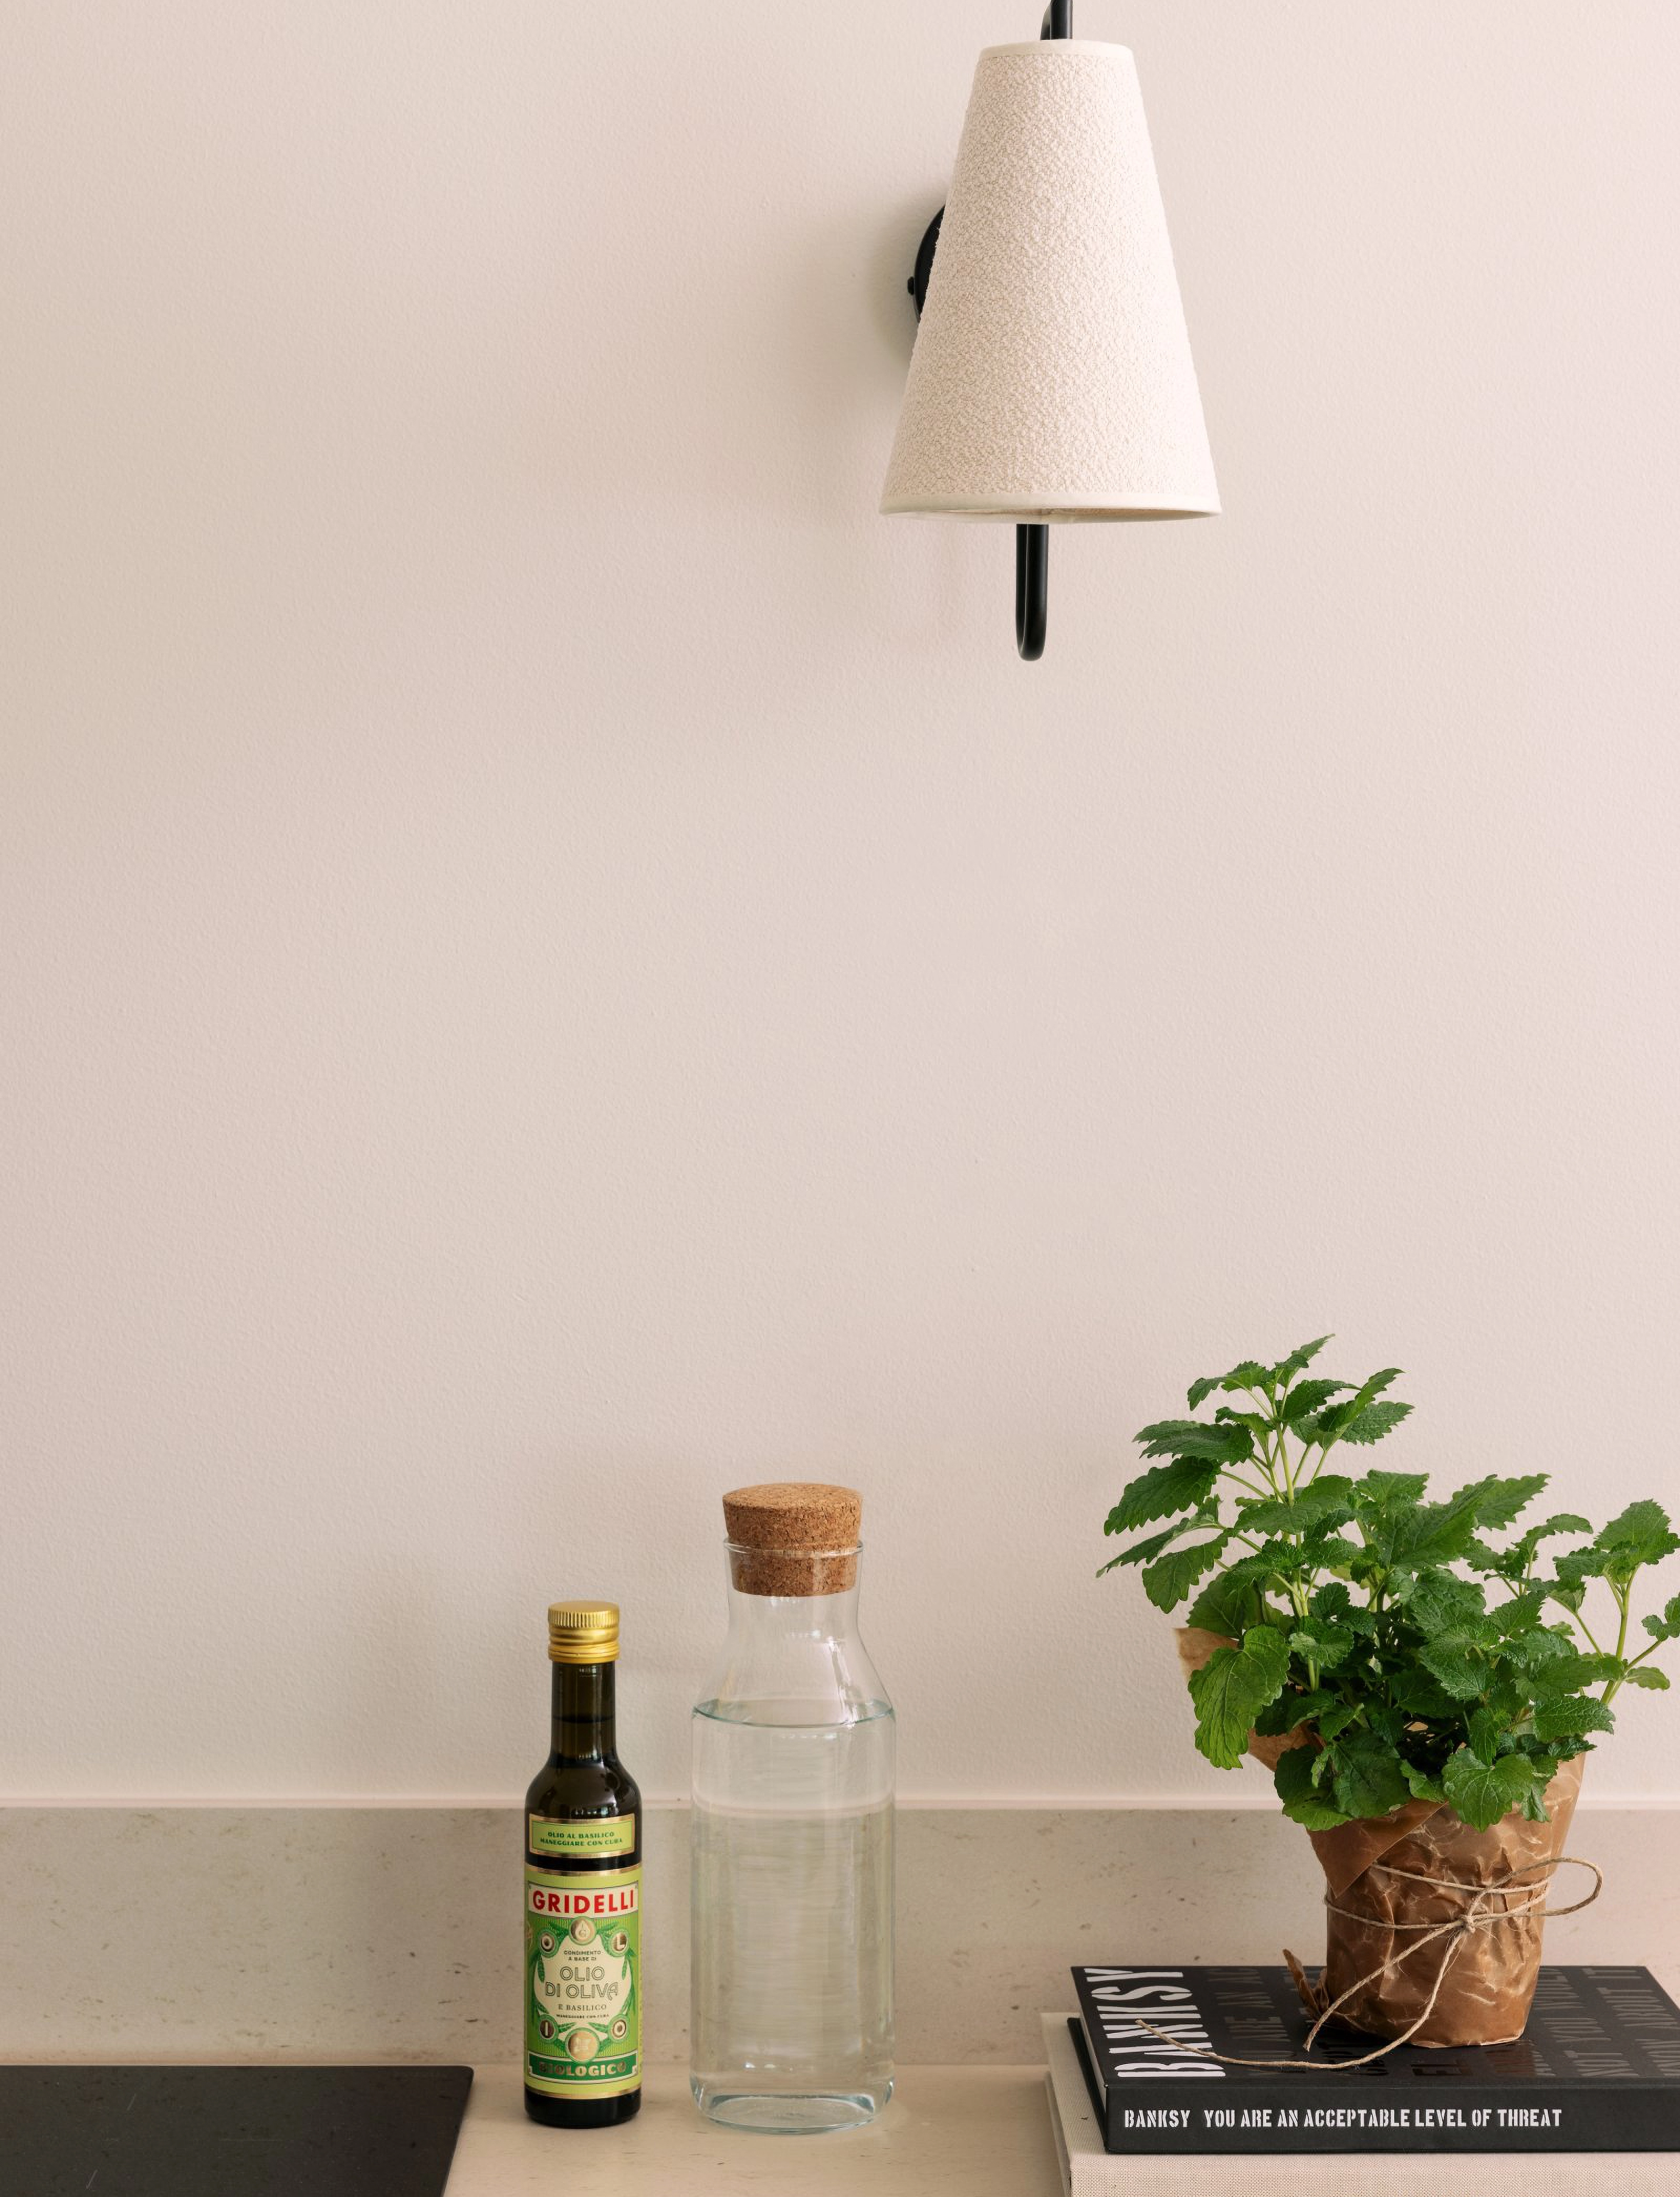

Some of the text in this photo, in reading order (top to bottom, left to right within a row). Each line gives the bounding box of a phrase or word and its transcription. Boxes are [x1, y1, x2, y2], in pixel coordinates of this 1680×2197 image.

[533, 1890, 633, 1914] GRIDELLI
[560, 1966, 604, 1981] OLIO
[545, 1982, 618, 2001] DI OLIVA
[1084, 1968, 1226, 2077] BANKSY
[539, 2061, 626, 2076] BIOLOGICO
[1125, 2109, 1562, 2128] BANKSY YOU ARE AN ACCEPTABLE LEVEL OF THREAT
